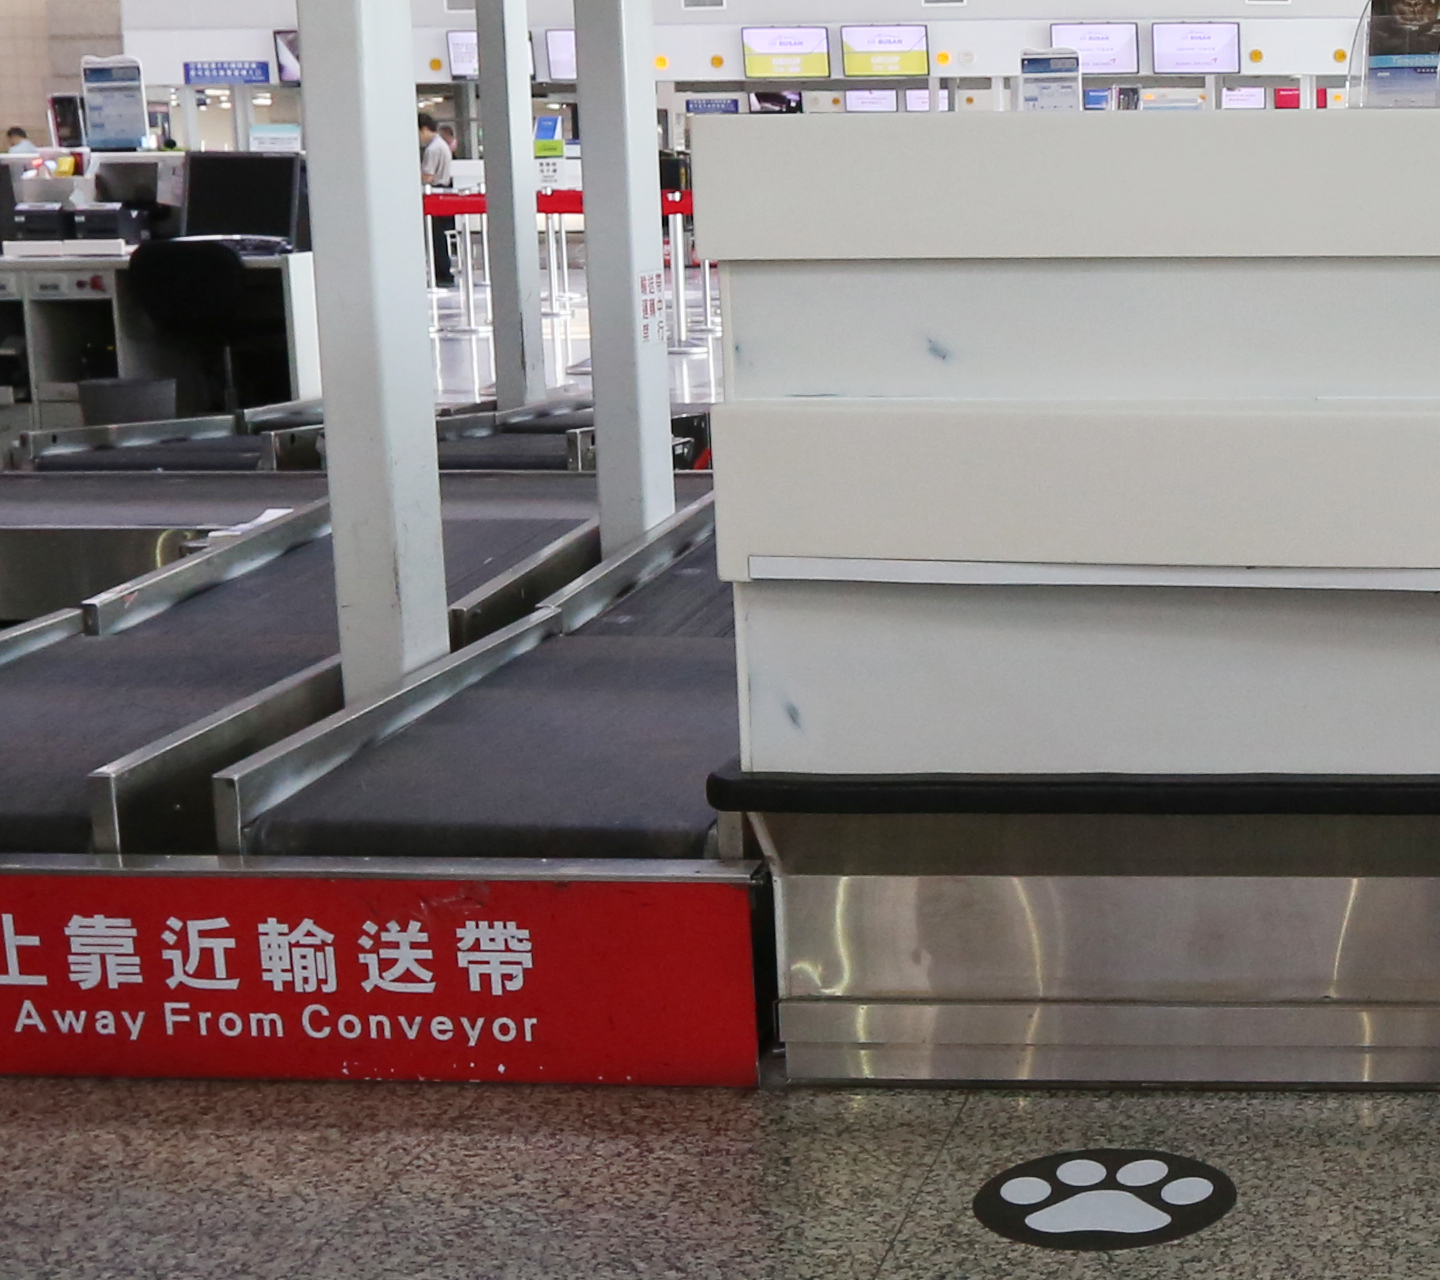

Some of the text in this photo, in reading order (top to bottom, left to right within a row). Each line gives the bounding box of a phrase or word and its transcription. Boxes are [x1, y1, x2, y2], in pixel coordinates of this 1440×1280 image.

[15, 1000, 146, 1041] Away
[163, 1001, 285, 1038] From
[301, 1003, 539, 1047] Conveyor
